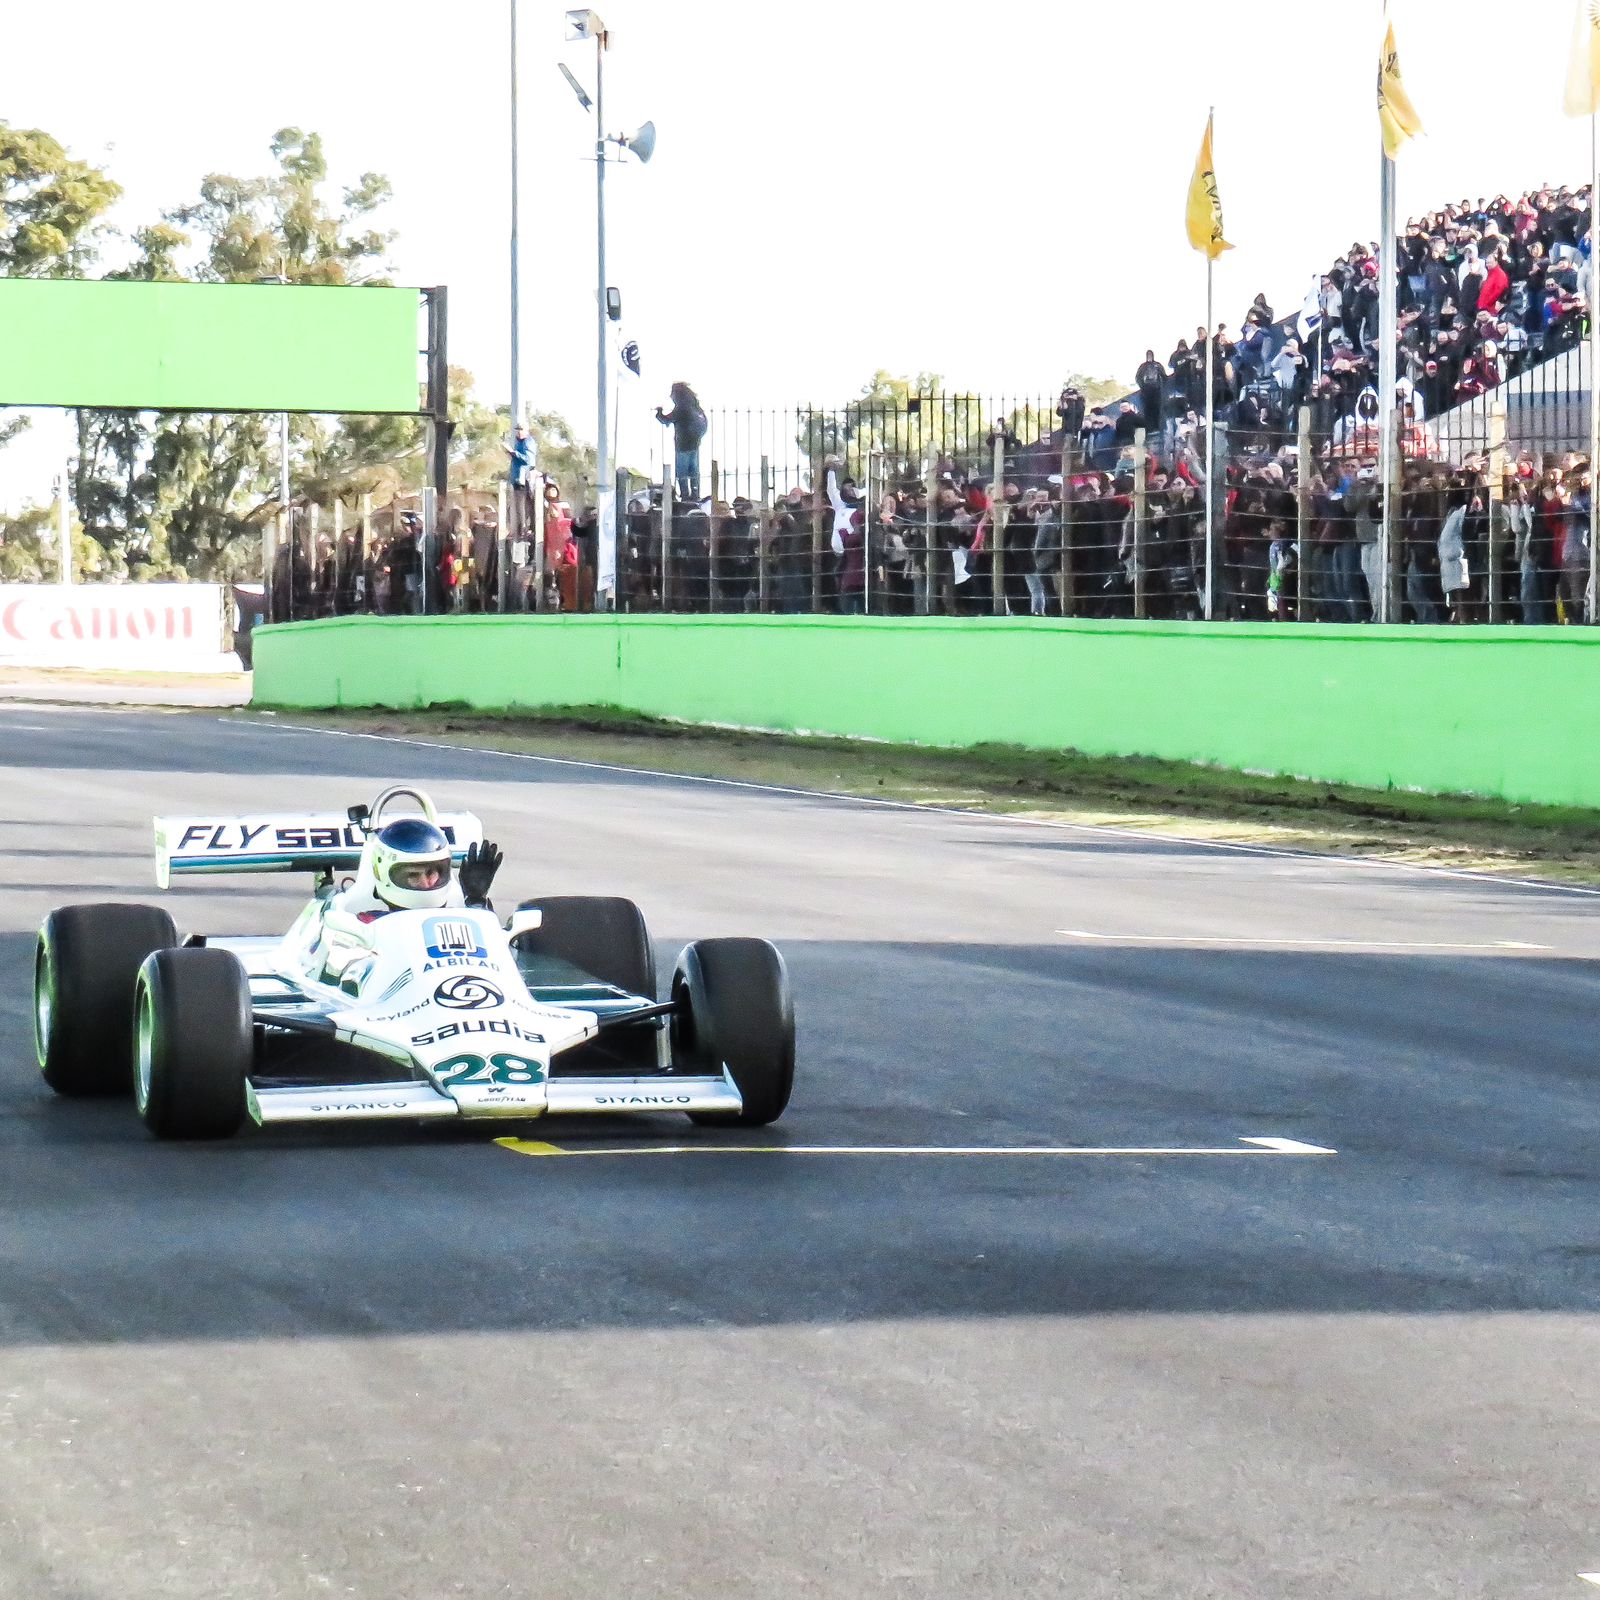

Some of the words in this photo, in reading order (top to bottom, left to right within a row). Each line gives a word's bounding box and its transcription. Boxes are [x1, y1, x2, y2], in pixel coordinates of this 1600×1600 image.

[2, 598, 193, 641] Canon
[177, 824, 270, 850] FLY
[366, 998, 431, 1022] Leyland
[410, 1018, 547, 1047] saudia
[430, 1052, 547, 1089] 28
[595, 1095, 691, 1104] SIYANCO
